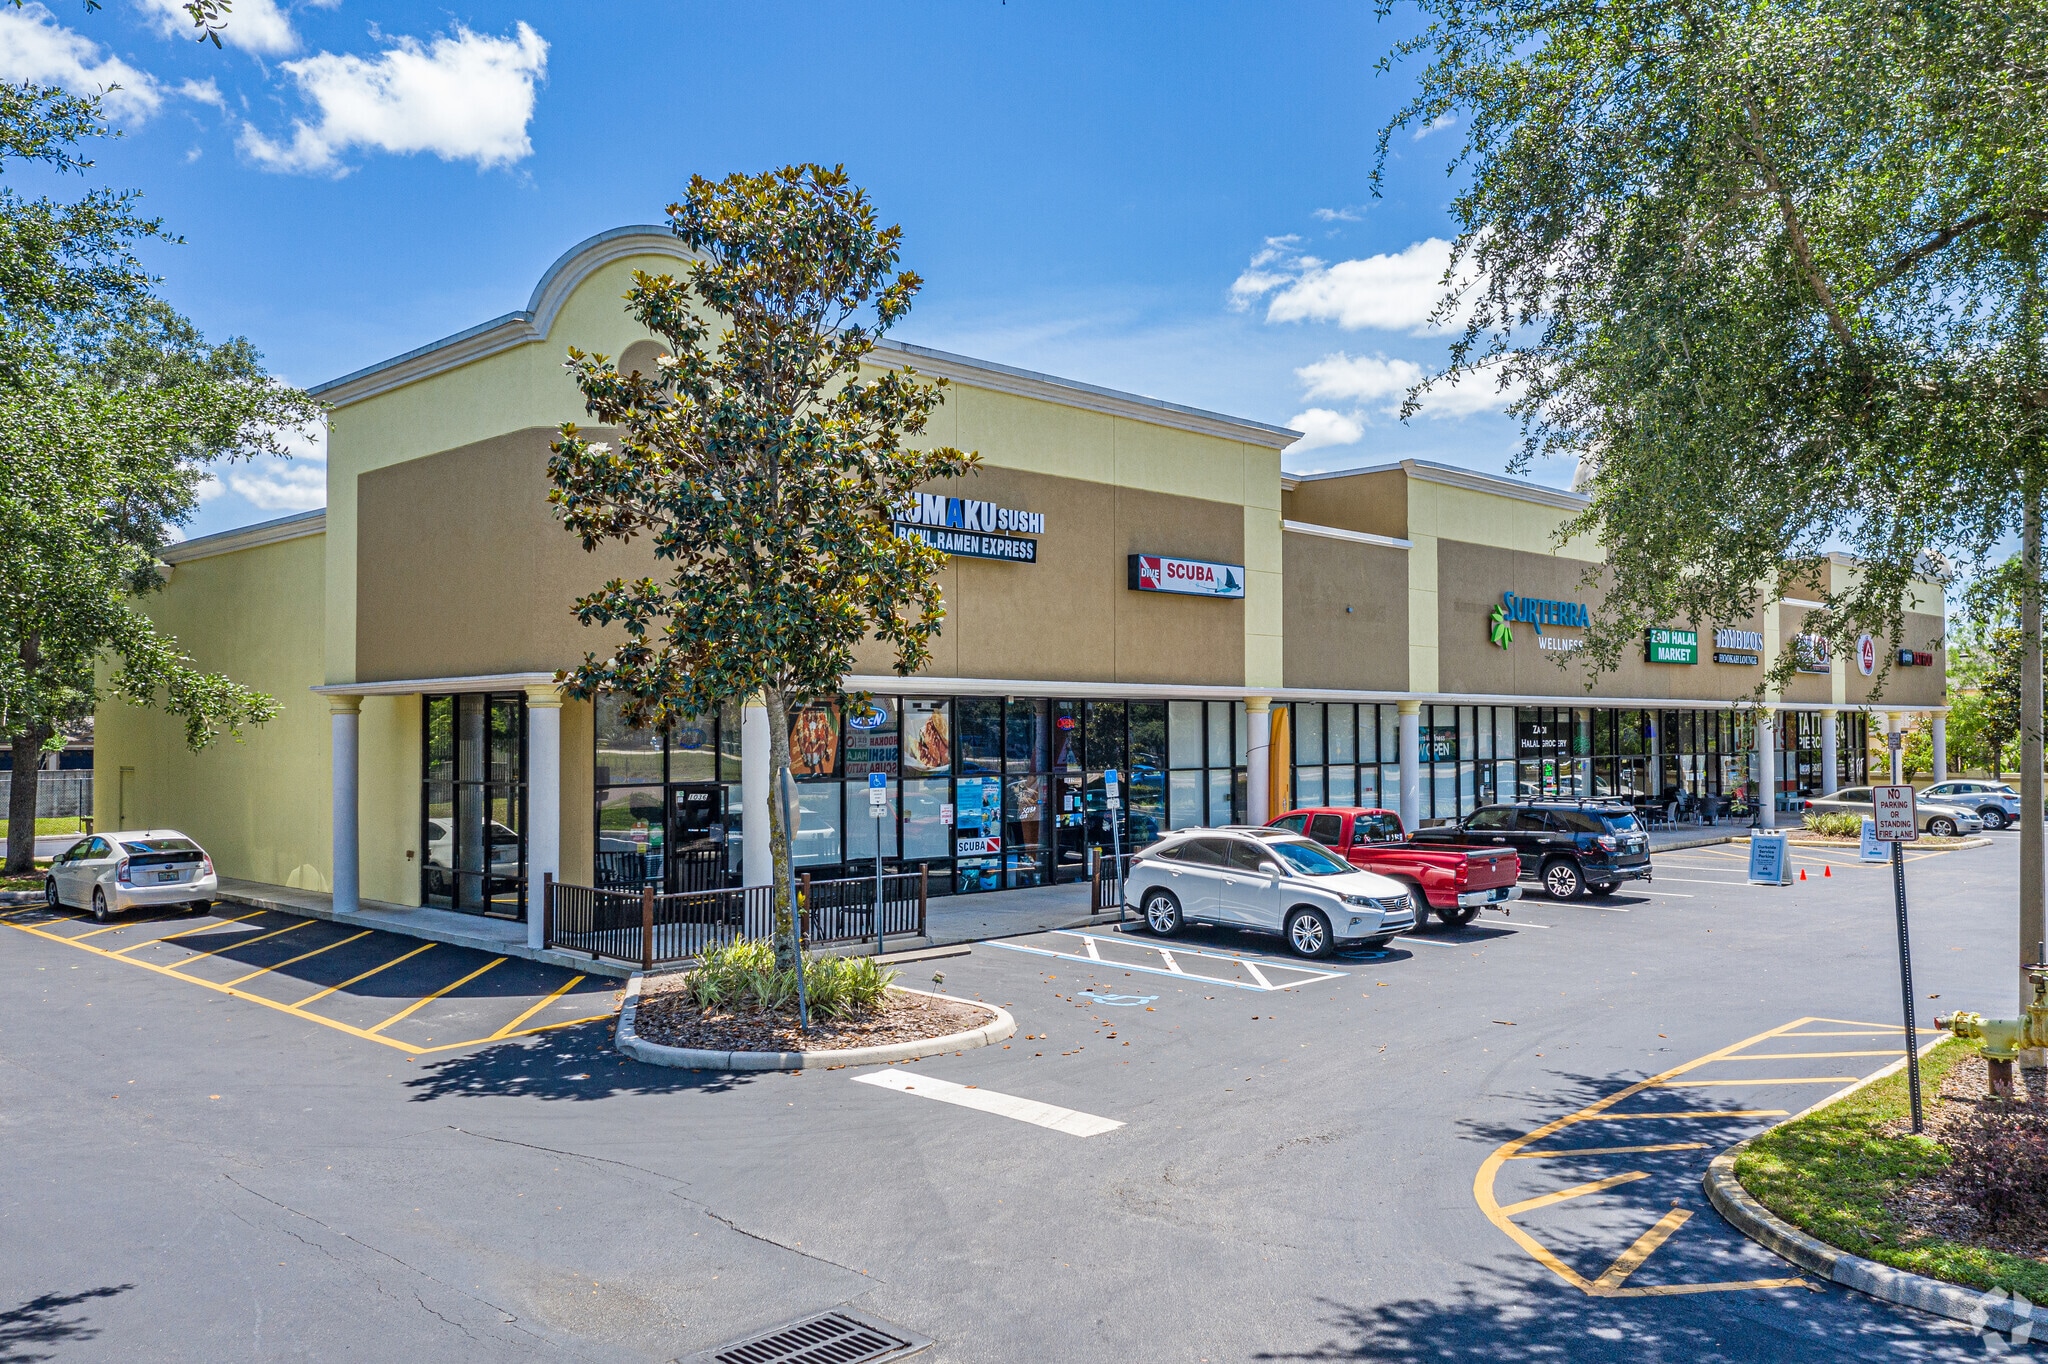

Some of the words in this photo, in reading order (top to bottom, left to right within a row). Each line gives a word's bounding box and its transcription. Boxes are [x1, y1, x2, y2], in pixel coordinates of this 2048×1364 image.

[891, 491, 997, 533] UMAKU
[998, 508, 1045, 534] SUSHI
[982, 537, 1034, 560] EXPRESS
[1141, 567, 1160, 579] DIVE
[1166, 562, 1215, 582] SCUBA
[1503, 591, 1591, 635] SURTERRA
[1538, 636, 1584, 651] WELLNESS
[1671, 631, 1697, 646] HALAL
[1658, 646, 1691, 662] MARKET
[1718, 653, 1739, 664] HOOKAH
[1739, 655, 1758, 665] LOUNGE
[1521, 739, 1541, 748] HALAL
[1888, 789, 1900, 799] NO
[1880, 801, 1908, 809] PARKING
[1880, 820, 1911, 828] STANDING
[1879, 830, 1893, 838] FIRE
[959, 841, 985, 852] SCUBA
